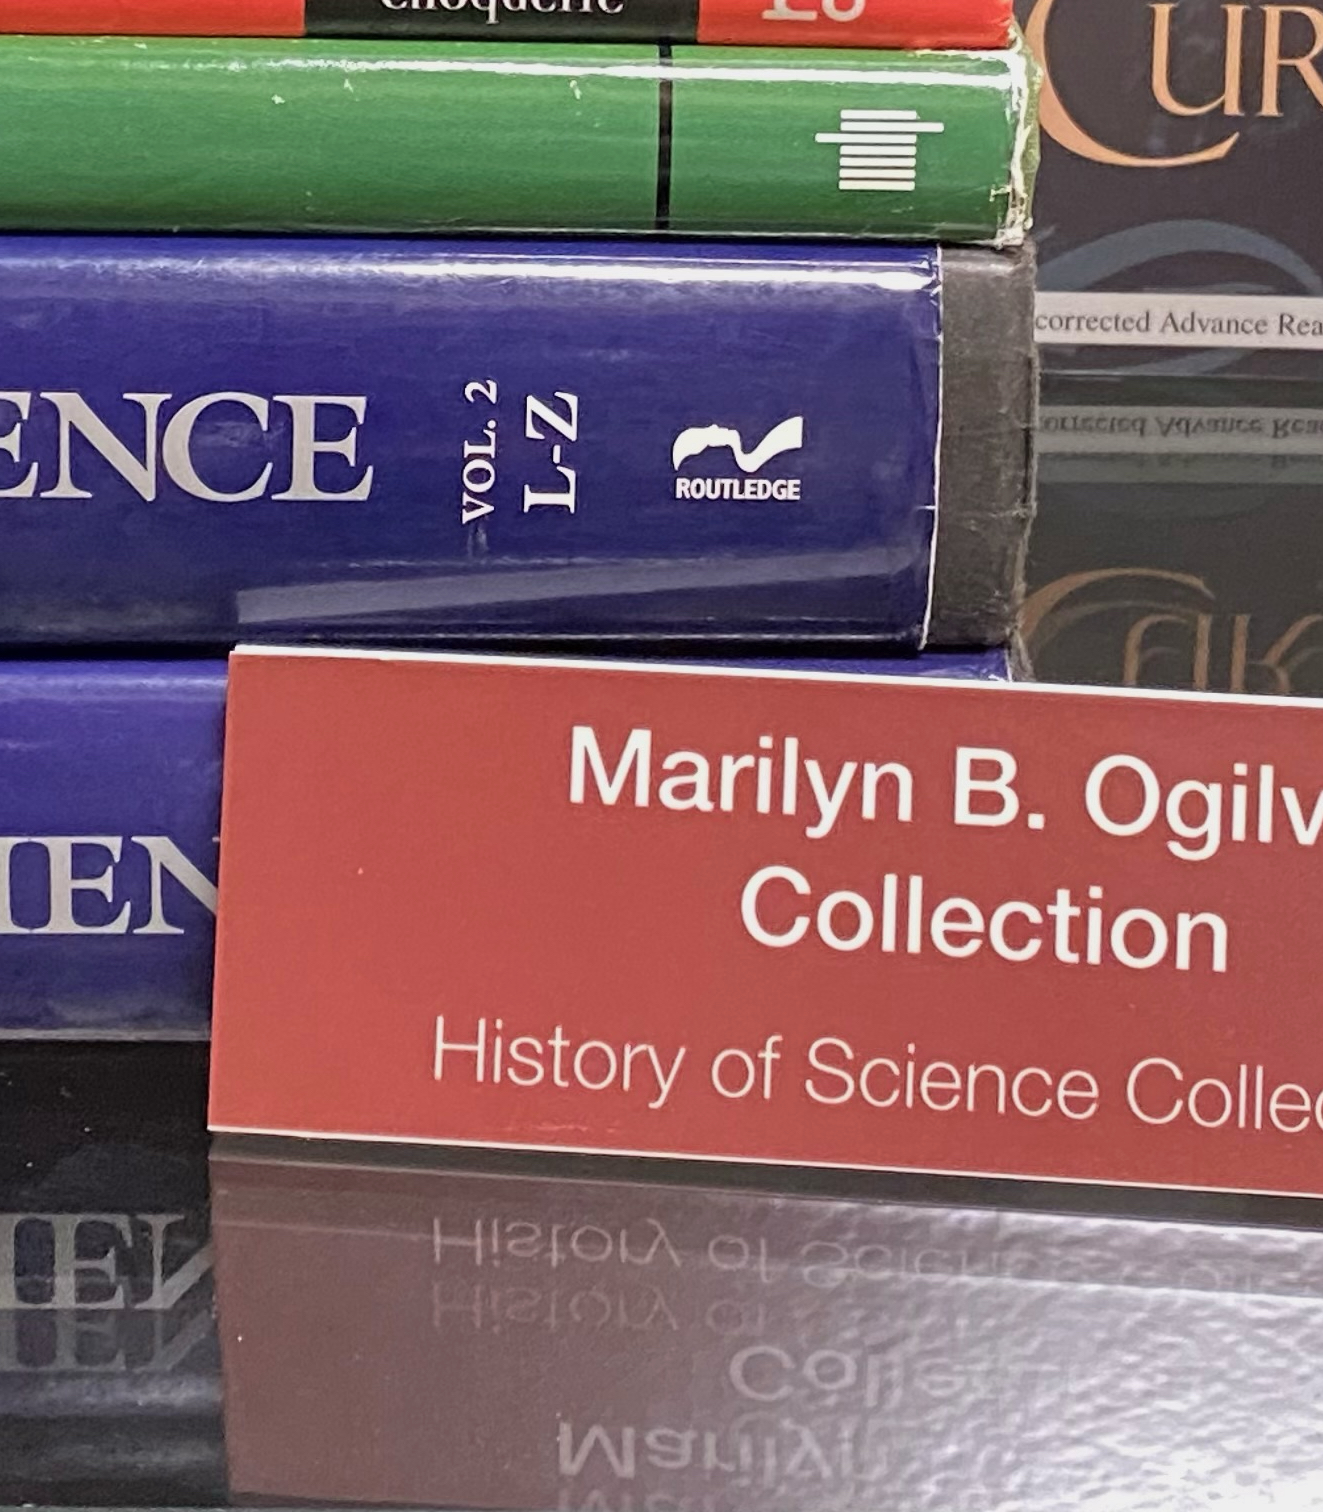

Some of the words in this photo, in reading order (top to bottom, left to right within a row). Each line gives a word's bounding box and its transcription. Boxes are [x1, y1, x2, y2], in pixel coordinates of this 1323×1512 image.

[1035, 309, 1149, 333] corrected
[1161, 310, 1267, 335] Advance
[464, 379, 498, 404] 2
[461, 418, 497, 525] VOL.
[523, 391, 579, 514] L-Z
[675, 477, 801, 501] ROUTLEDGE
[570, 724, 913, 841] Marilyn
[955, 746, 1046, 831] B.
[741, 864, 1230, 975] Collection
[432, 1014, 688, 1109] History
[709, 1031, 784, 1103] of
[803, 1037, 1101, 1122] Science
